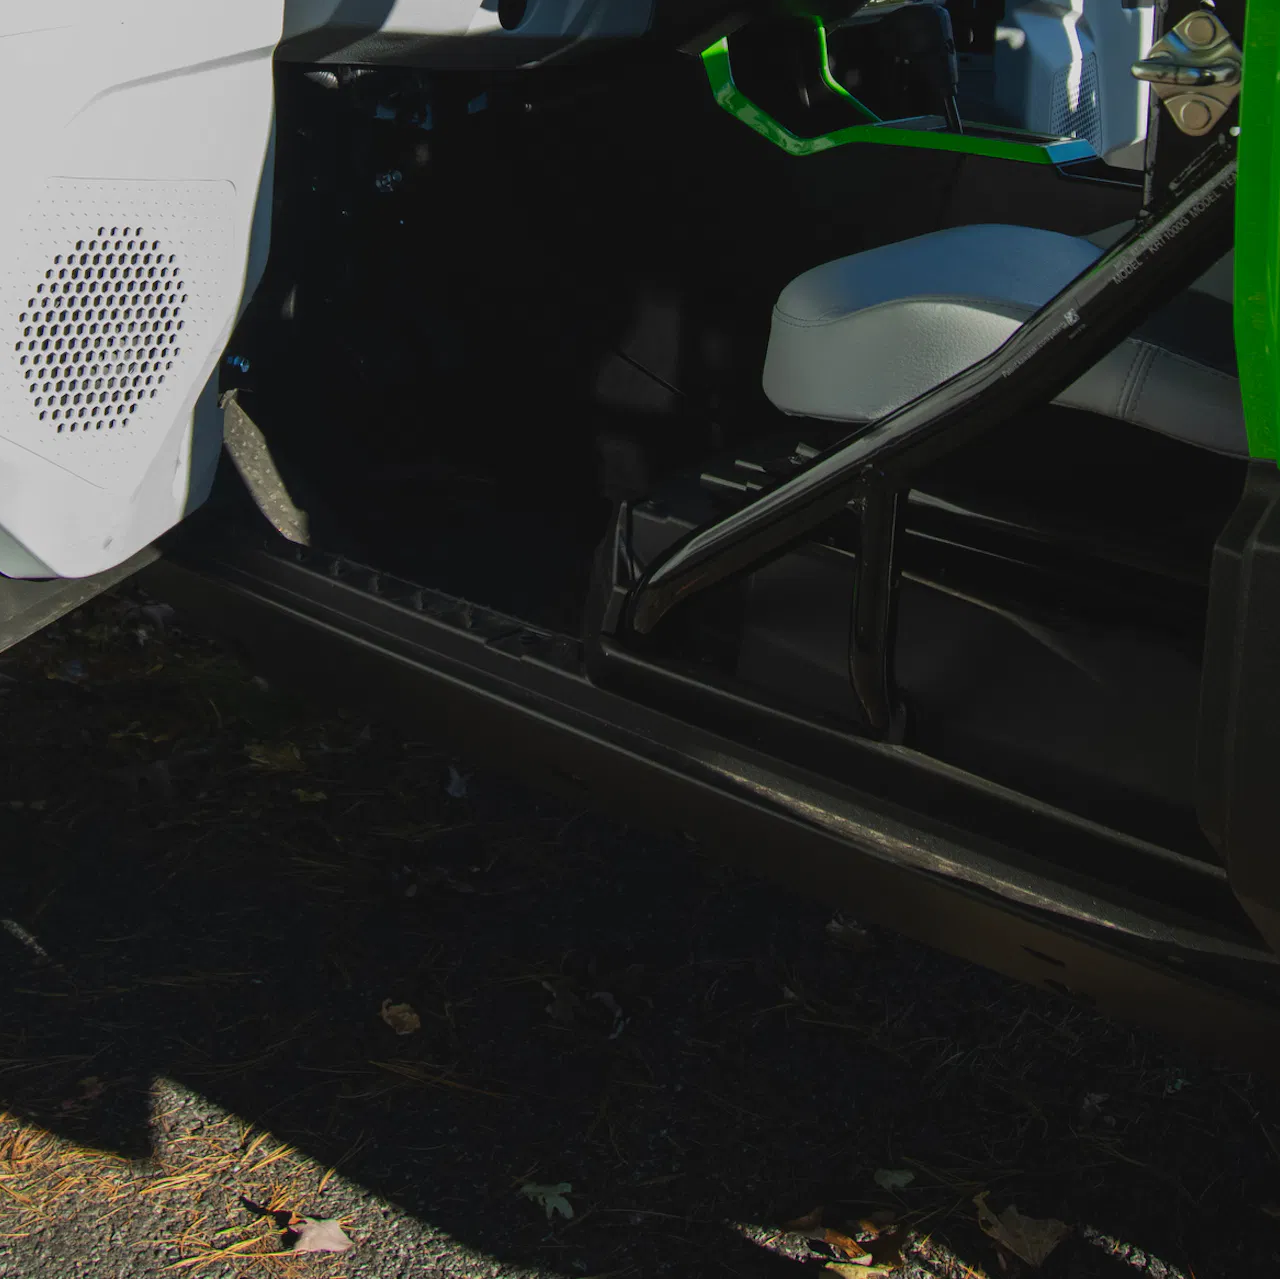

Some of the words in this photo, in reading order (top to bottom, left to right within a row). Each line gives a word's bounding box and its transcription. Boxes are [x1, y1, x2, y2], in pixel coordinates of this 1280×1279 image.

[1112, 258, 1144, 285] MODEL
[1149, 218, 1190, 255] KRT1000G
[1189, 191, 1222, 219] MODEL
